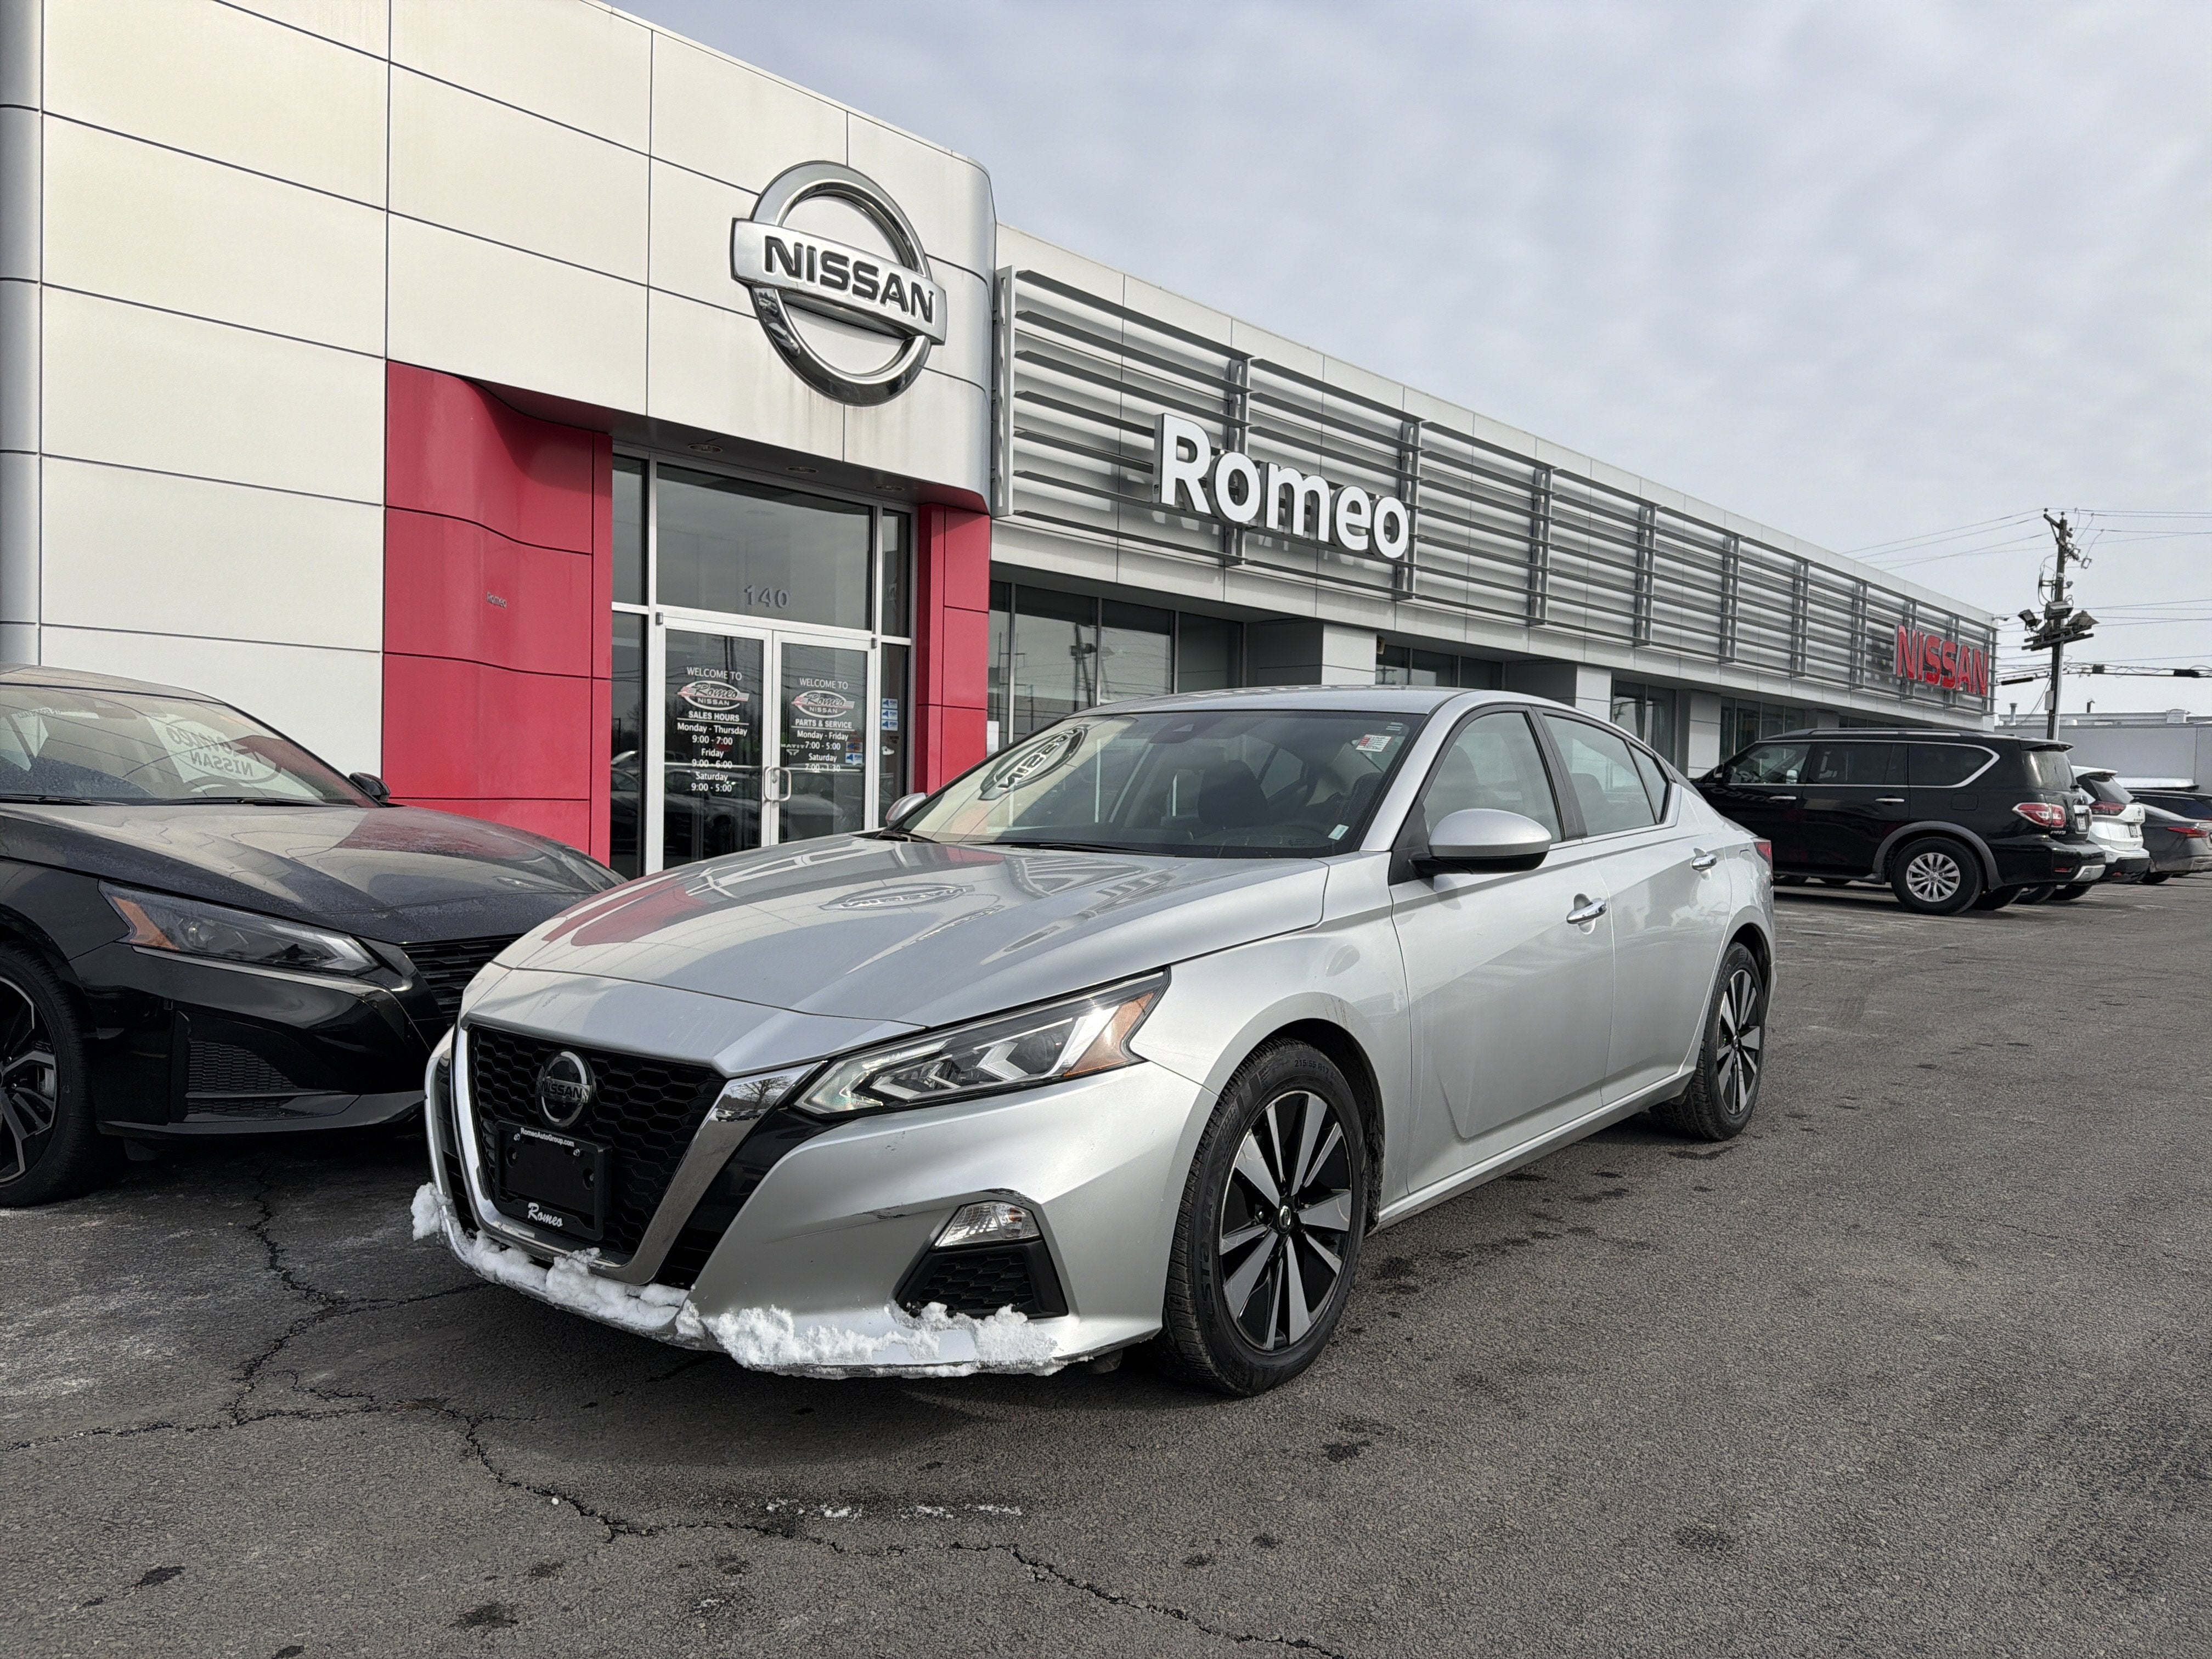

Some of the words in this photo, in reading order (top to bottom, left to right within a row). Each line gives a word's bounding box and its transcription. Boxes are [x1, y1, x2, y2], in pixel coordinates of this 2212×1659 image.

[765, 235, 935, 325] NISSAN
[1154, 413, 1410, 558] Romeo
[744, 585, 790, 608] 140
[1895, 624, 1989, 697] NISSAN
[687, 667, 728, 679] WELCOME
[730, 672, 742, 681] TO
[693, 682, 738, 698] Romeo
[799, 678, 836, 689] WELCOME
[838, 681, 848, 690] TO
[804, 692, 845, 706] Romeo
[689, 710, 712, 720] SALES
[714, 713, 740, 721] HOURS
[677, 723, 707, 733] Monday
[713, 725, 748, 737] Thursday
[795, 718, 817, 726] PARTS
[825, 720, 852, 729] SERVICE
[692, 735, 709, 744] 9:00
[716, 736, 733, 745] 7:00
[797, 730, 823, 740] Monday
[829, 732, 849, 741] Friday
[805, 741, 820, 749] 7:00
[701, 748, 724, 758] Friday
[808, 753, 837, 763] Saturday
[692, 759, 709, 768] 9:00
[715, 760, 732, 769] 6:00
[696, 771, 728, 781] Saturday
[691, 783, 708, 791] 9:00
[715, 784, 732, 792] 5:00
[541, 1080, 583, 1099] NISSAN
[520, 1127, 575, 1148] RomeoAutoGroup.com
[528, 1202, 563, 1228] Romeo
